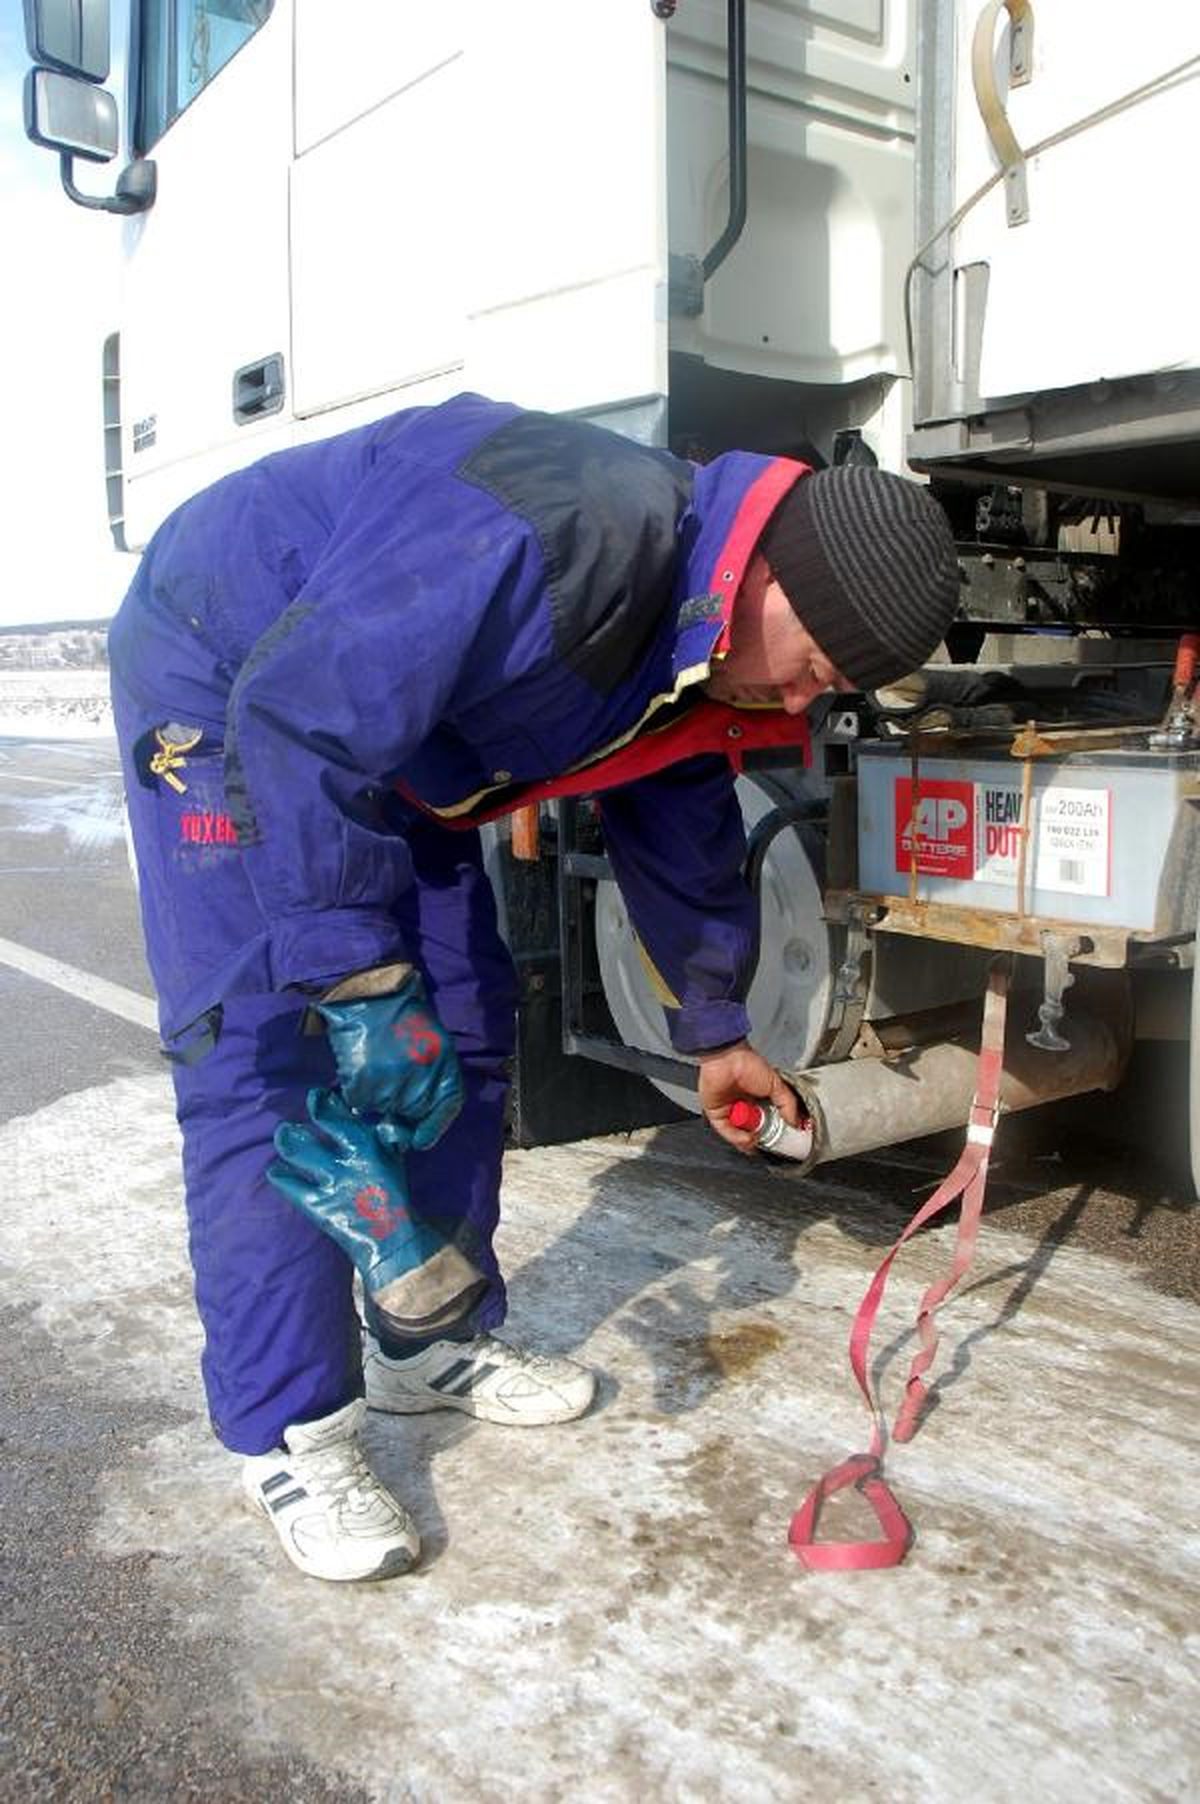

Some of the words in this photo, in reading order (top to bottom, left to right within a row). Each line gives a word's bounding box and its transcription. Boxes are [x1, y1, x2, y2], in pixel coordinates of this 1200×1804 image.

[902, 798, 967, 841] AP
[985, 790, 1024, 823] HEAV
[985, 825, 1025, 859] DUT
